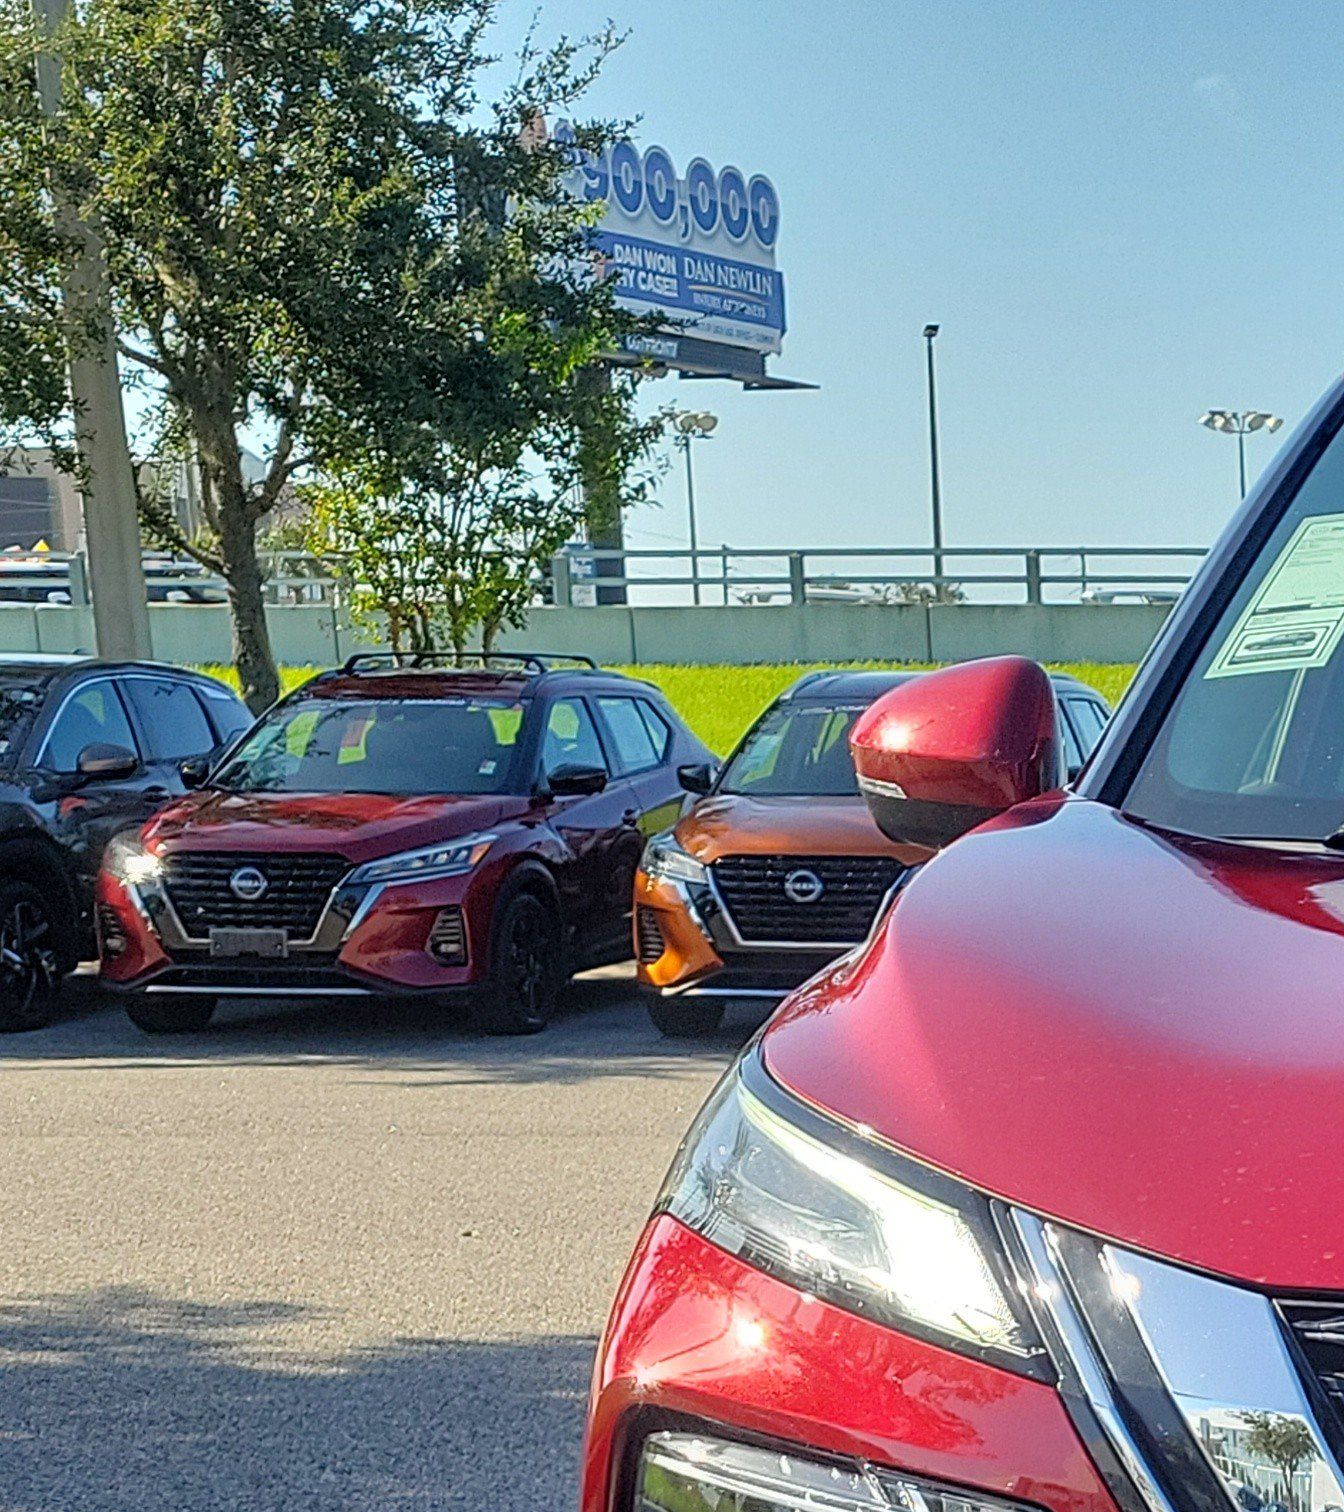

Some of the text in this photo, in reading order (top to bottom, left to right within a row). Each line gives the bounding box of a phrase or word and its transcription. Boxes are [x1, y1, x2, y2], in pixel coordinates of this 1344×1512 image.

[613, 243, 677, 275] DAN WON
[684, 257, 773, 297] DAN NEWLIN
